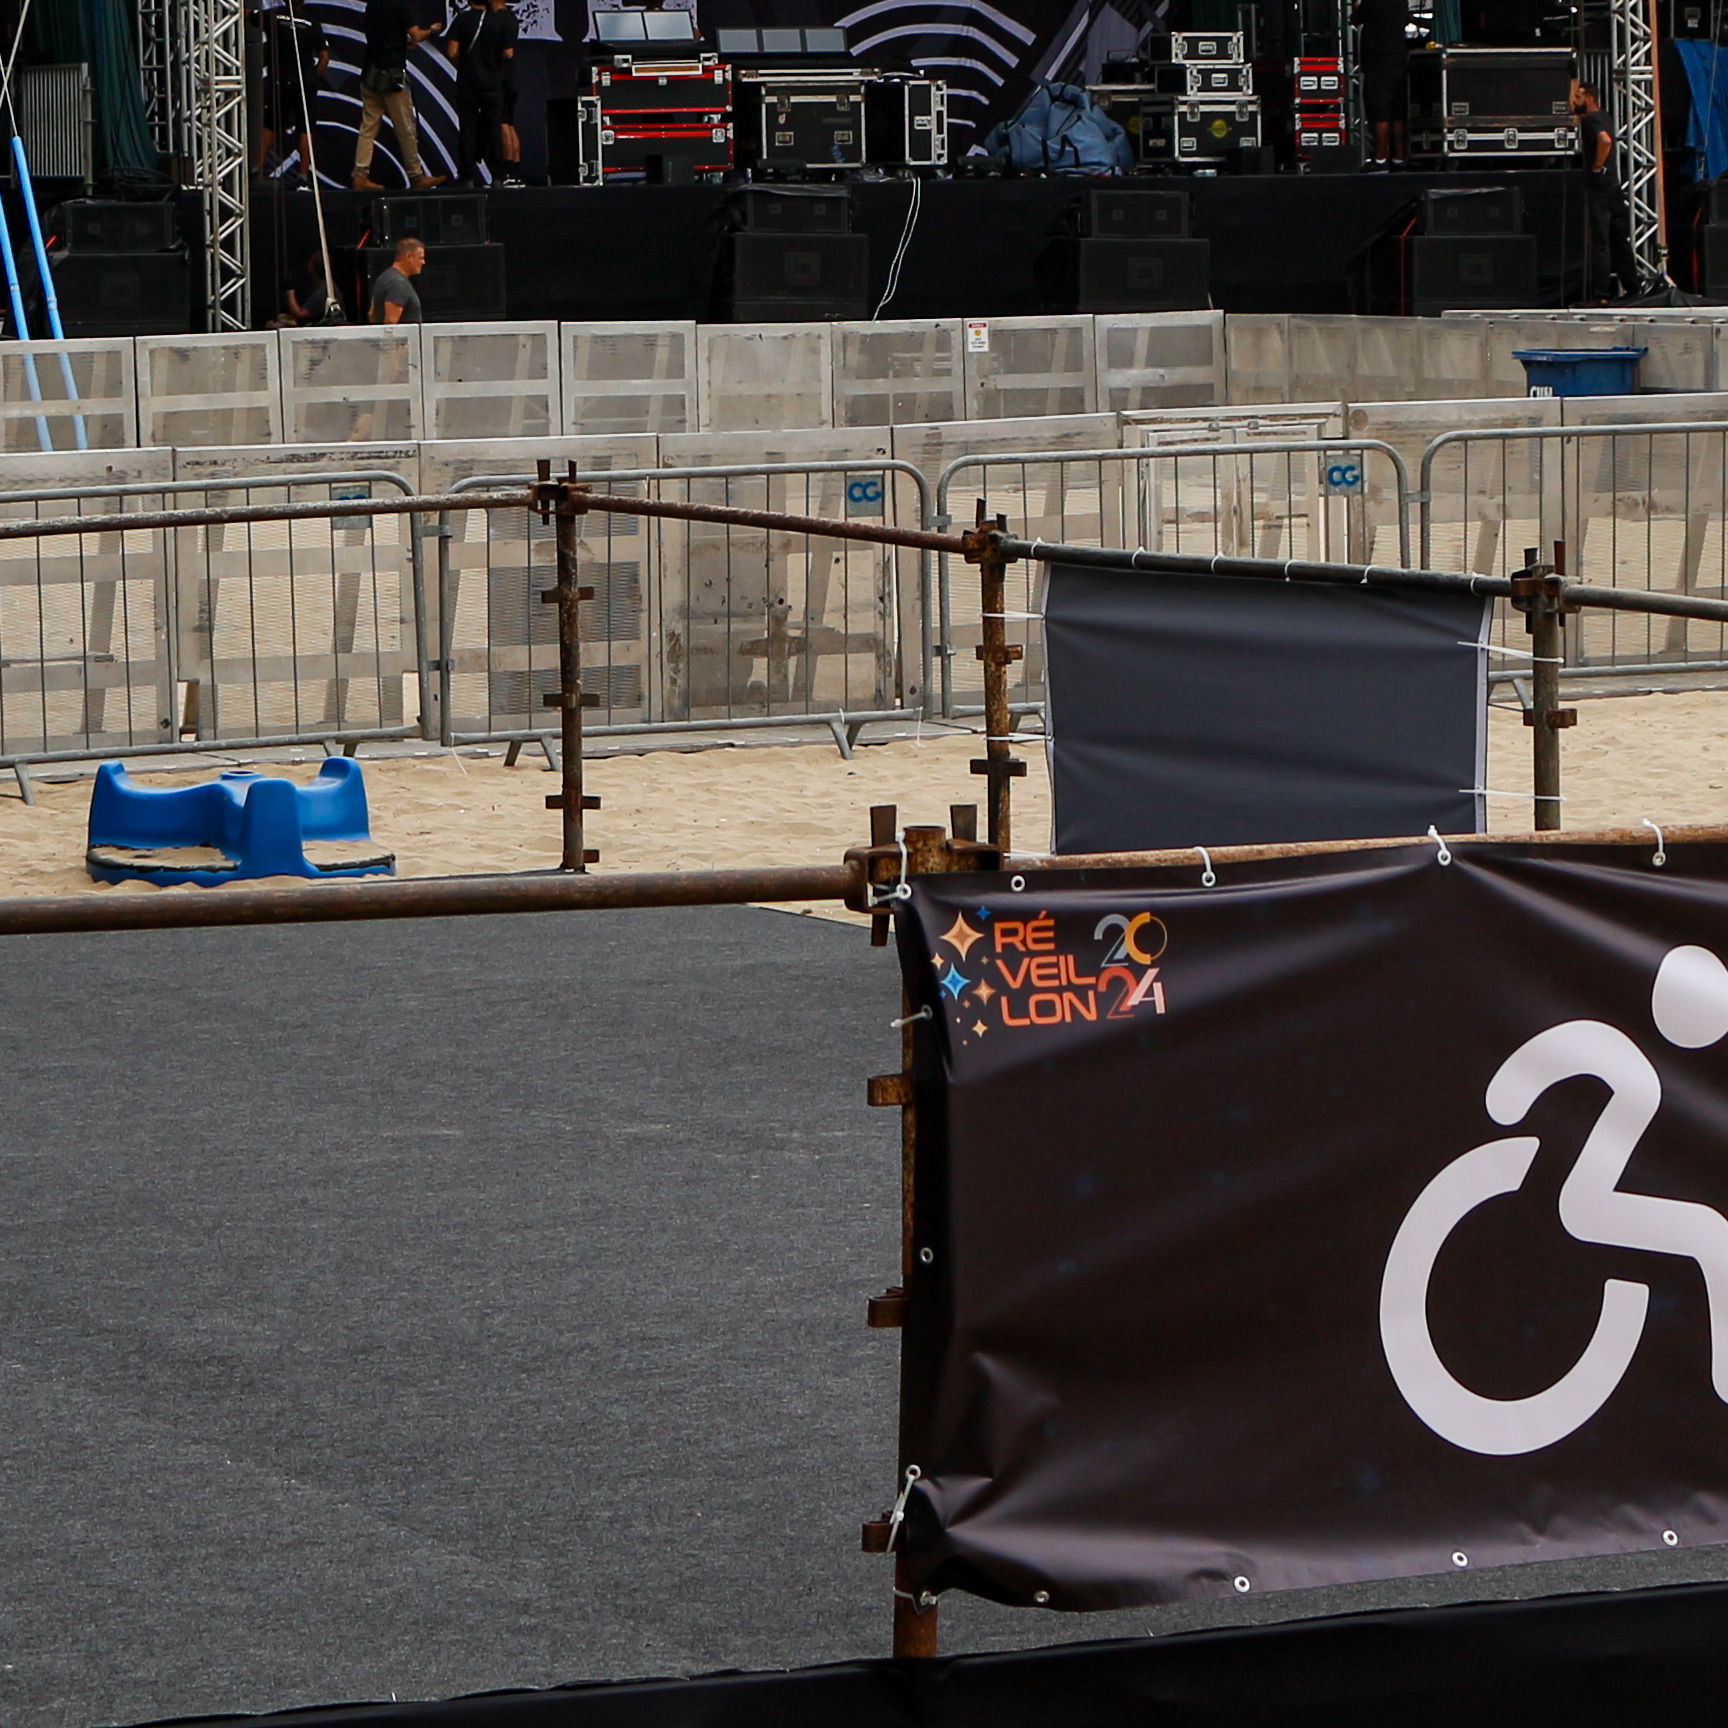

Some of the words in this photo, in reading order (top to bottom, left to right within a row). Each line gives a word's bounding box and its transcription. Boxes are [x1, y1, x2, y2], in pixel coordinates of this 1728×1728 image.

[848, 481, 882, 503] CG
[1328, 465, 1360, 487] CG
[994, 910, 1055, 952] RÉ
[996, 953, 1096, 990] VEIL
[1001, 991, 1097, 1026] LON
